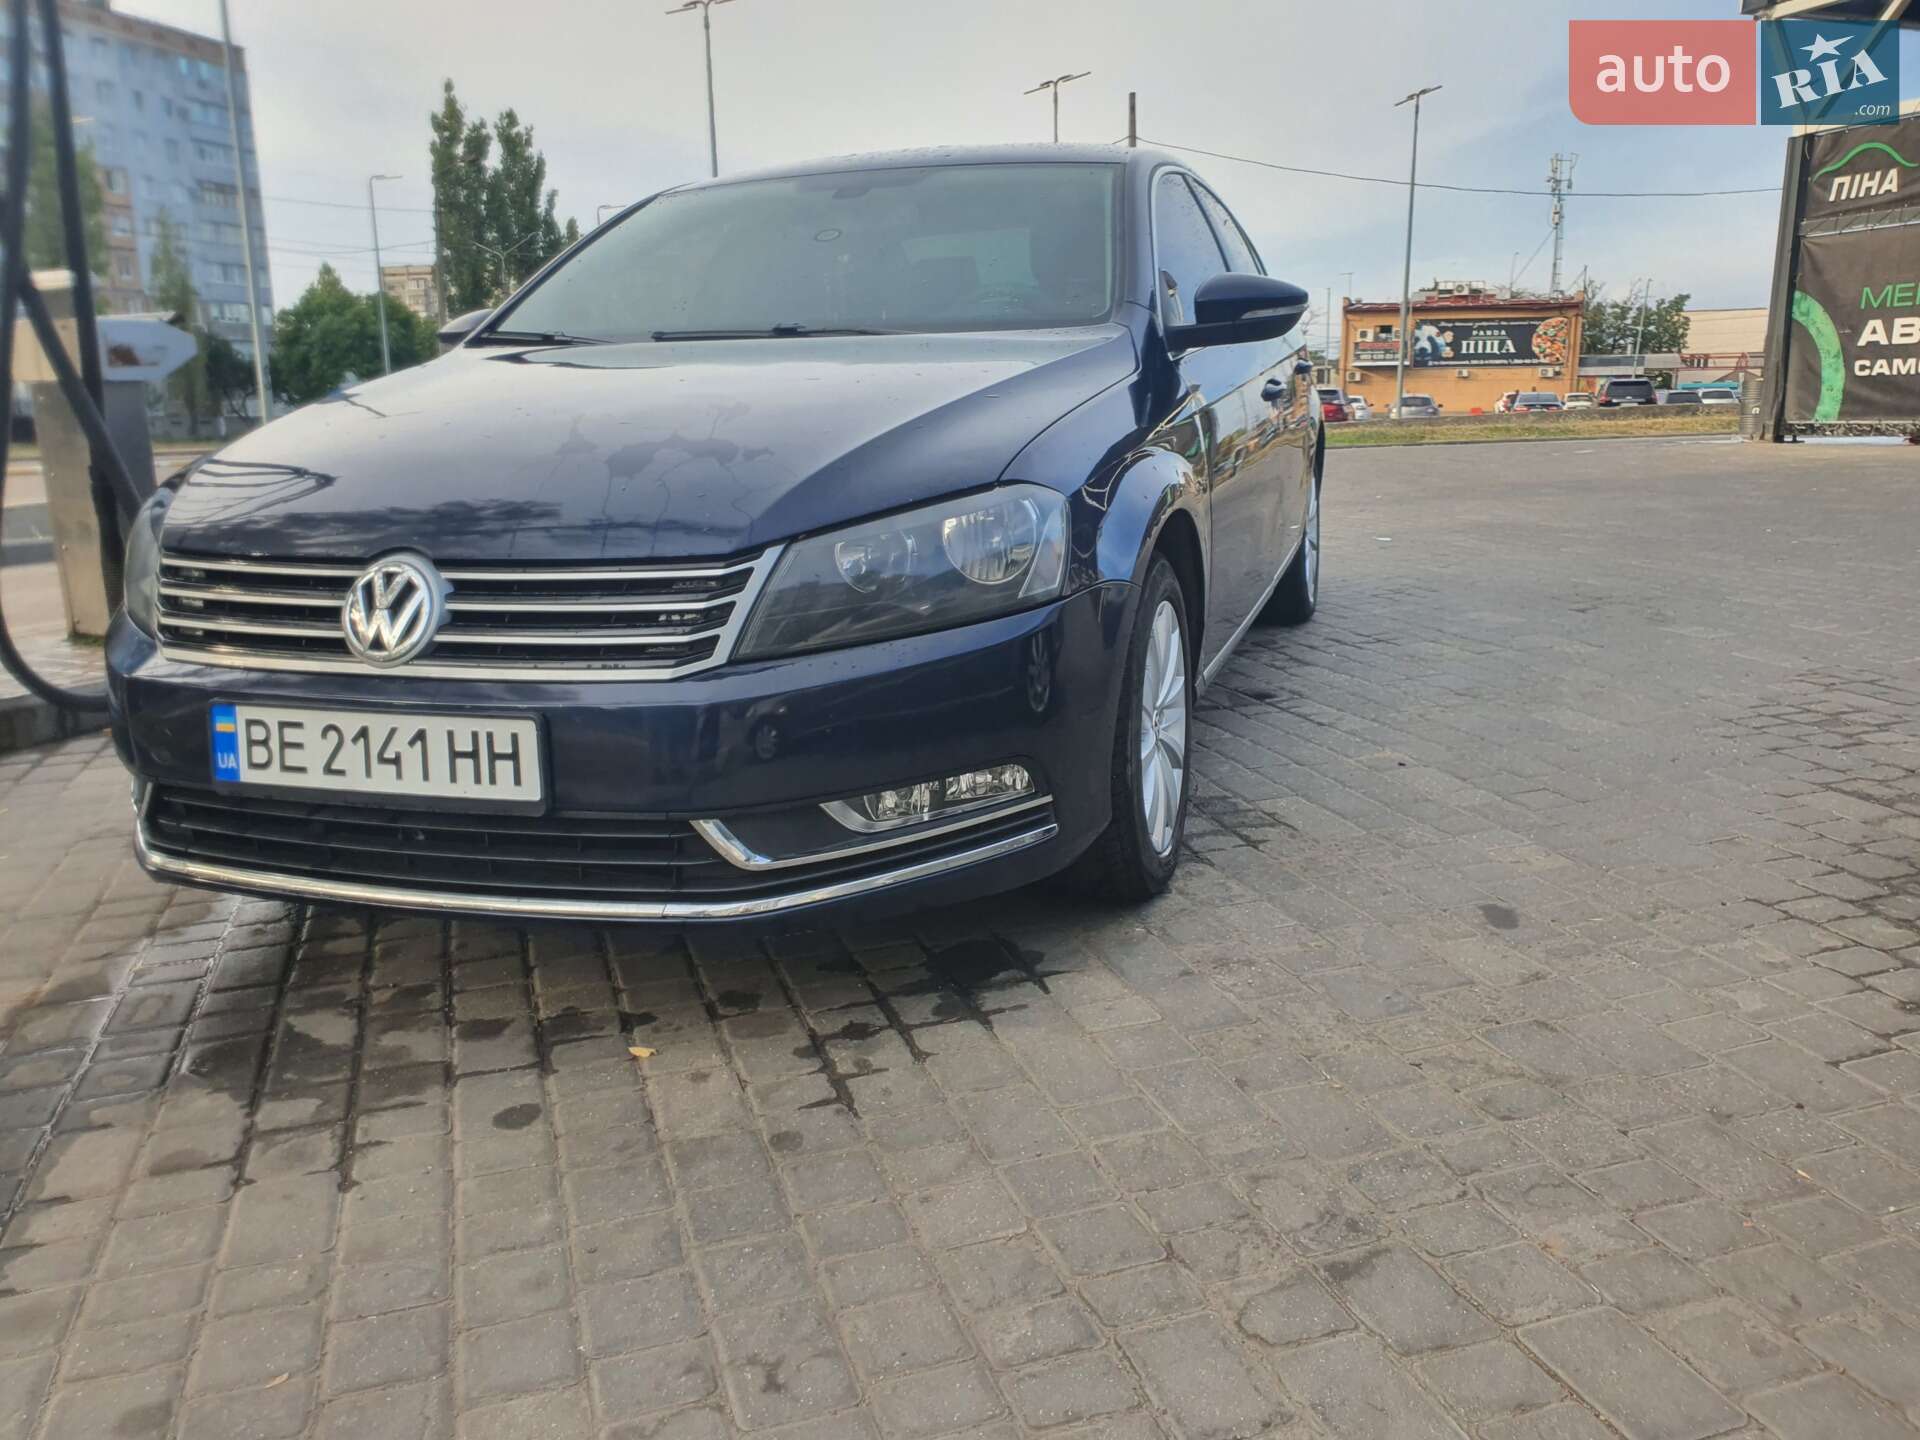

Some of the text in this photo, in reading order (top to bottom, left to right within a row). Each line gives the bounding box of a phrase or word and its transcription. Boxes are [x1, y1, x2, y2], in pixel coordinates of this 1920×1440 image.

[1829, 167, 1898, 202] ПІНА
[1860, 282, 1920, 310] МЕ
[1460, 340, 1517, 355] ПІЦА
[1854, 357, 1920, 377] САМ
[217, 752, 238, 768] UA
[245, 718, 522, 787] BE 2141 HH
